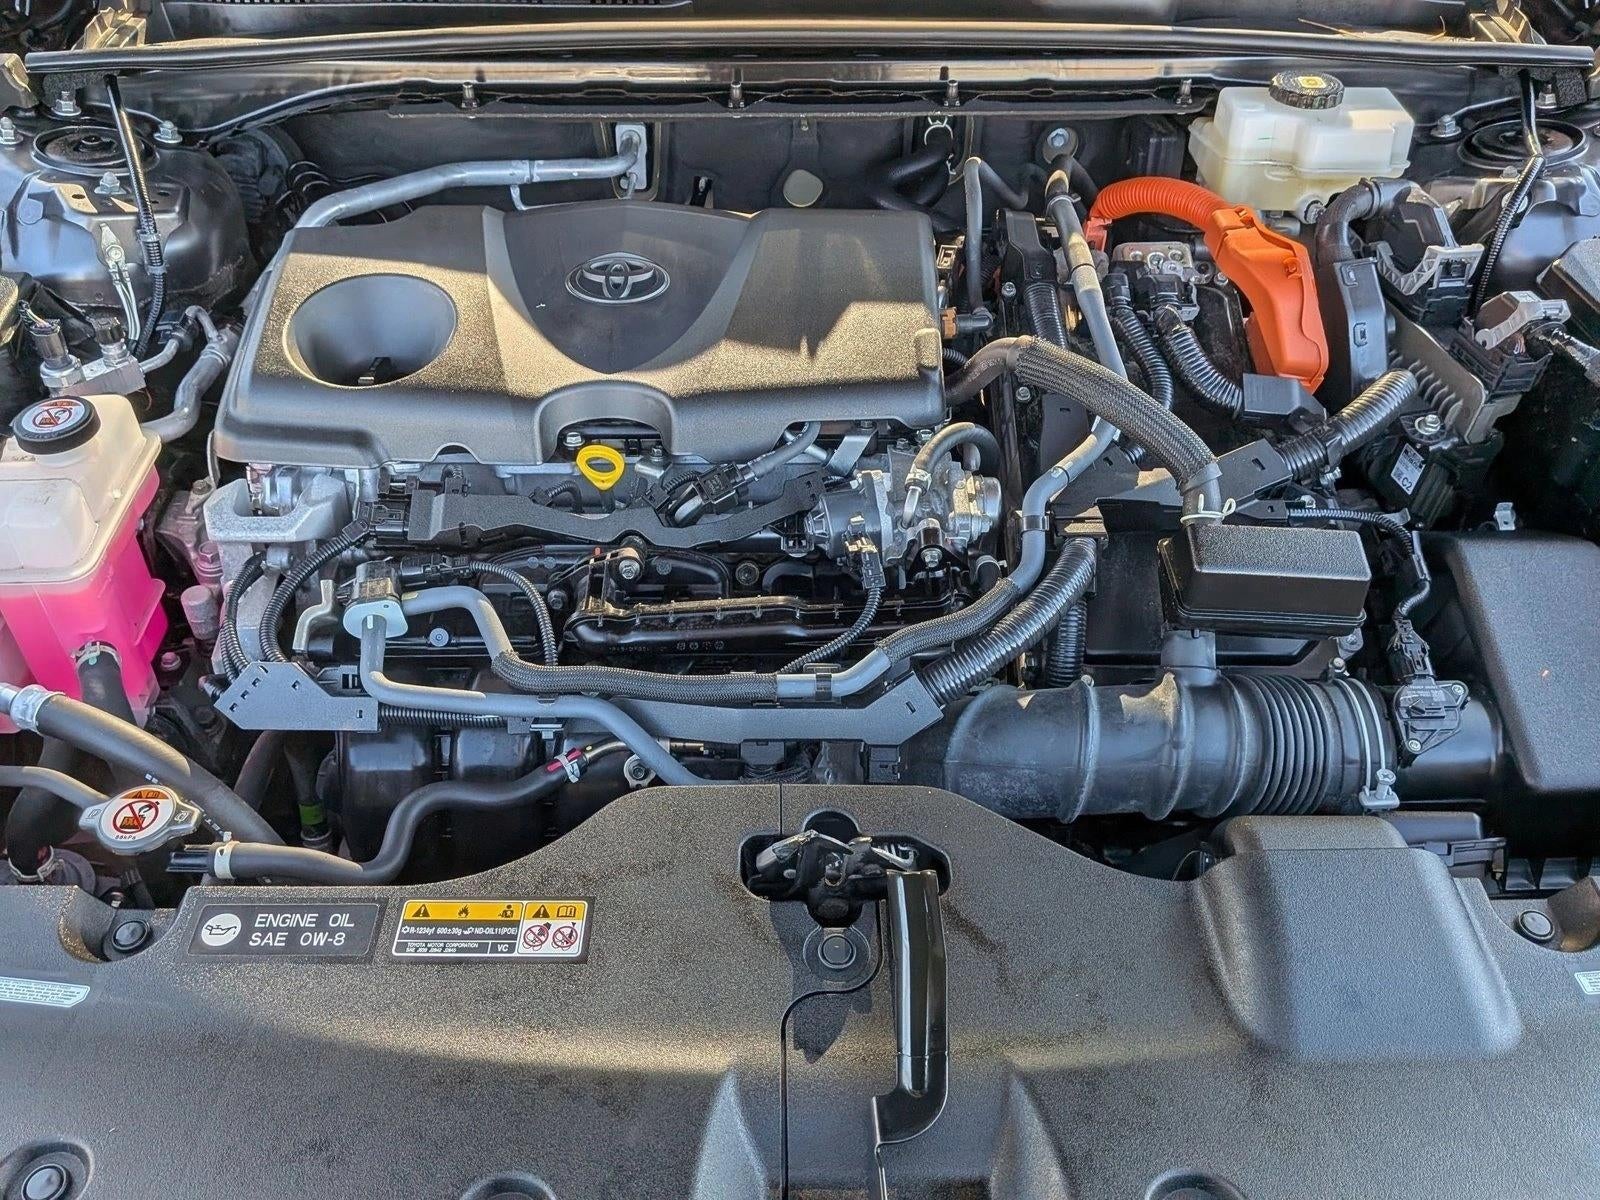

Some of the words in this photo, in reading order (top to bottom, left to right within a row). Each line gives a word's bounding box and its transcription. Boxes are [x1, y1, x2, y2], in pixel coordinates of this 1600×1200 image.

[1401, 477, 1412, 491] C2
[254, 913, 319, 928] ENGINE
[328, 913, 355, 928] OIL
[249, 932, 289, 947] SAE
[299, 932, 346, 947] 0W-8
[497, 943, 509, 952] VC
